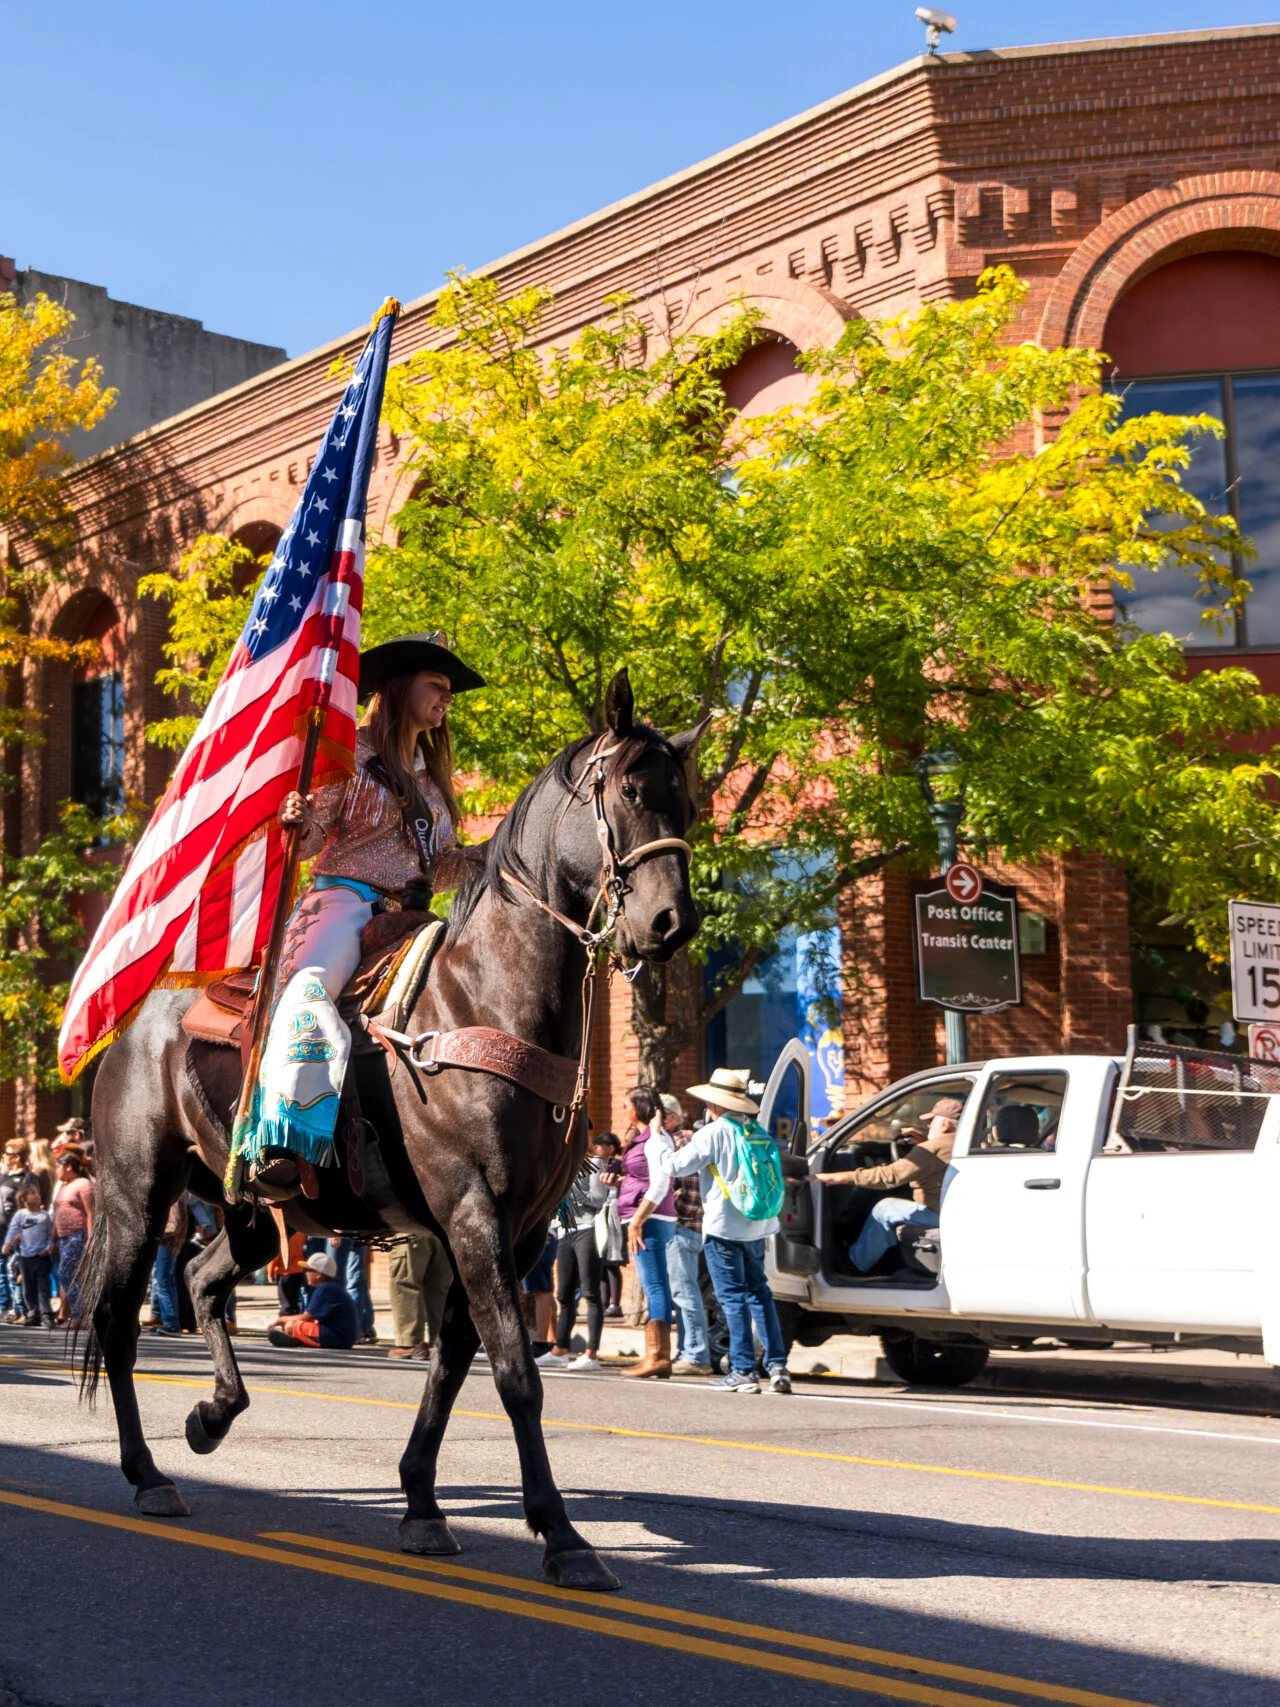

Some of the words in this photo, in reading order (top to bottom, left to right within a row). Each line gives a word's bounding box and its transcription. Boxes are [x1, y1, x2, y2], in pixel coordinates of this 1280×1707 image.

[927, 904, 957, 920] Post
[960, 906, 1004, 922] Office
[1237, 915, 1280, 937] SPEE
[921, 933, 968, 949] Transit
[970, 934, 1013, 950] Center
[1247, 965, 1280, 1009] 15
